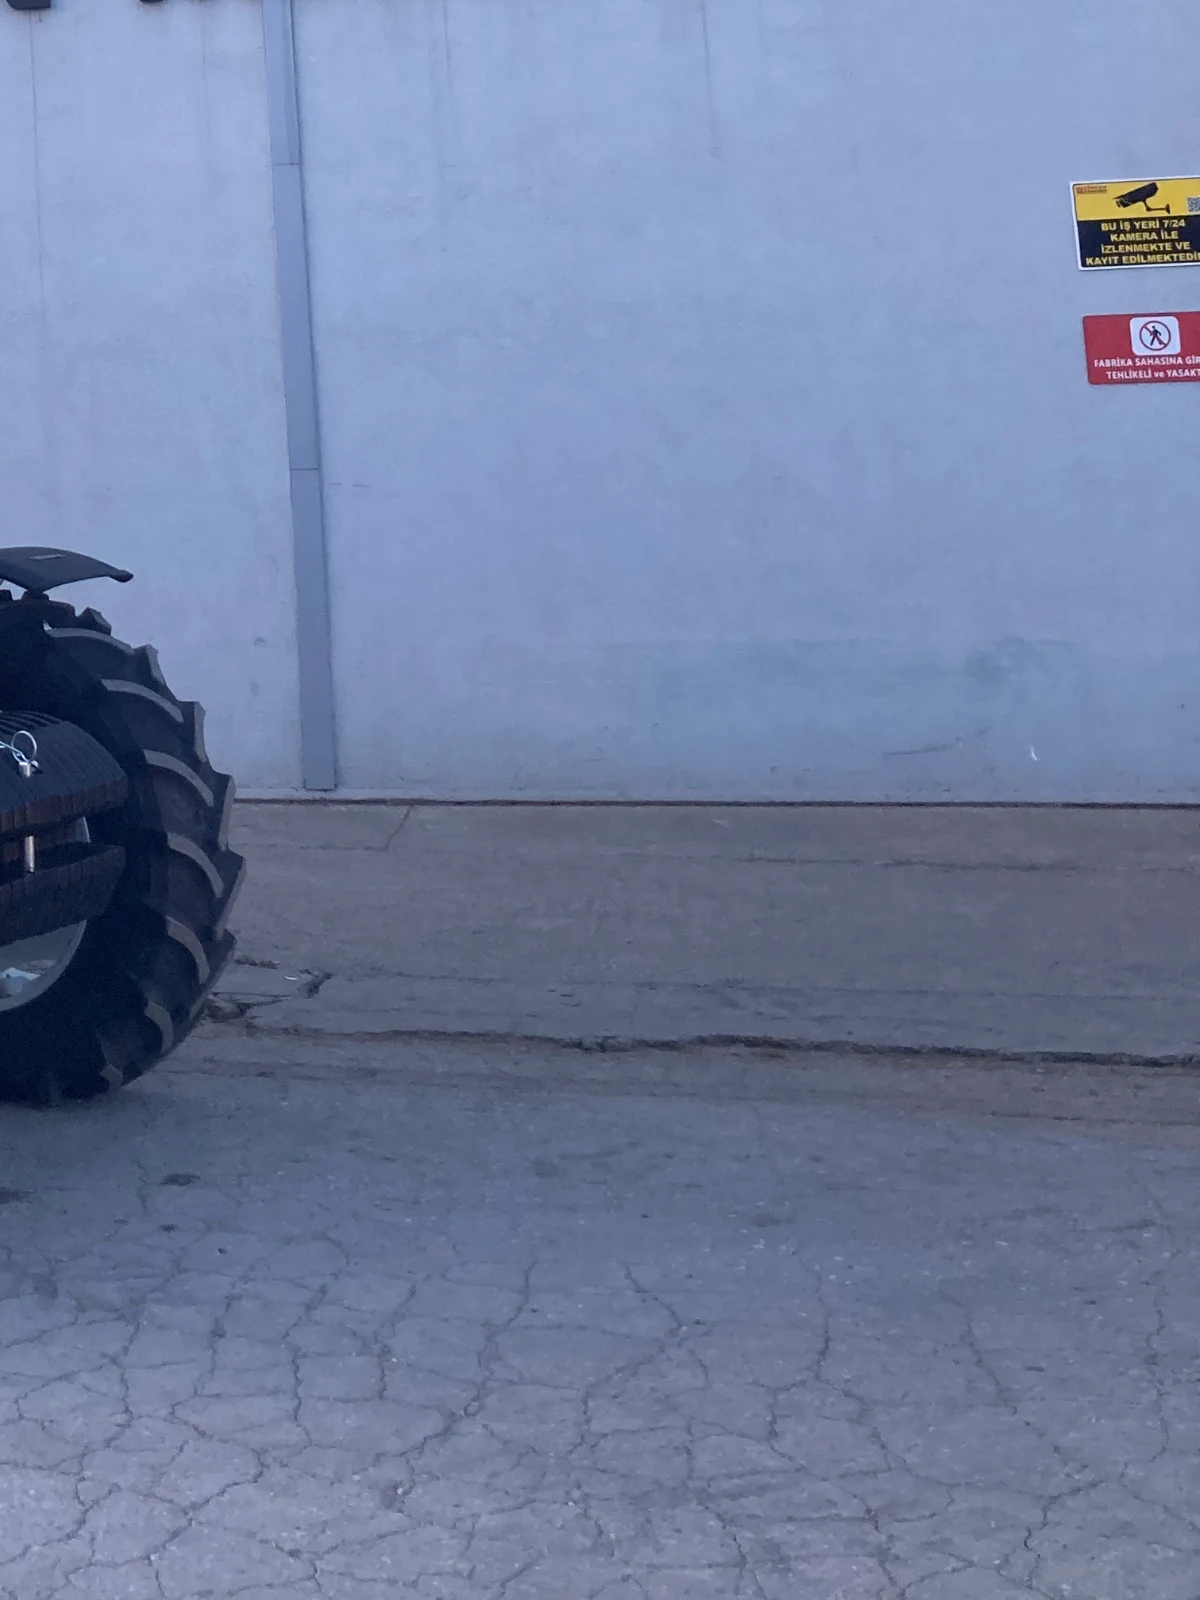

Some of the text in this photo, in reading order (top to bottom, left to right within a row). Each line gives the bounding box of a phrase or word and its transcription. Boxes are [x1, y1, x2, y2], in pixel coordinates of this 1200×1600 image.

[1100, 219, 1186, 232] BU İŞ YERİ 7/24
[1110, 229, 1179, 242] KAMERA İLE
[1100, 241, 1191, 254] İZLENMEKTE VE
[1085, 256, 1119, 267] KAYIT
[1093, 357, 1133, 368] FABRİKA
[1135, 356, 1184, 367] SAHASINA
[1105, 369, 1152, 380] TEHLİKELİ
